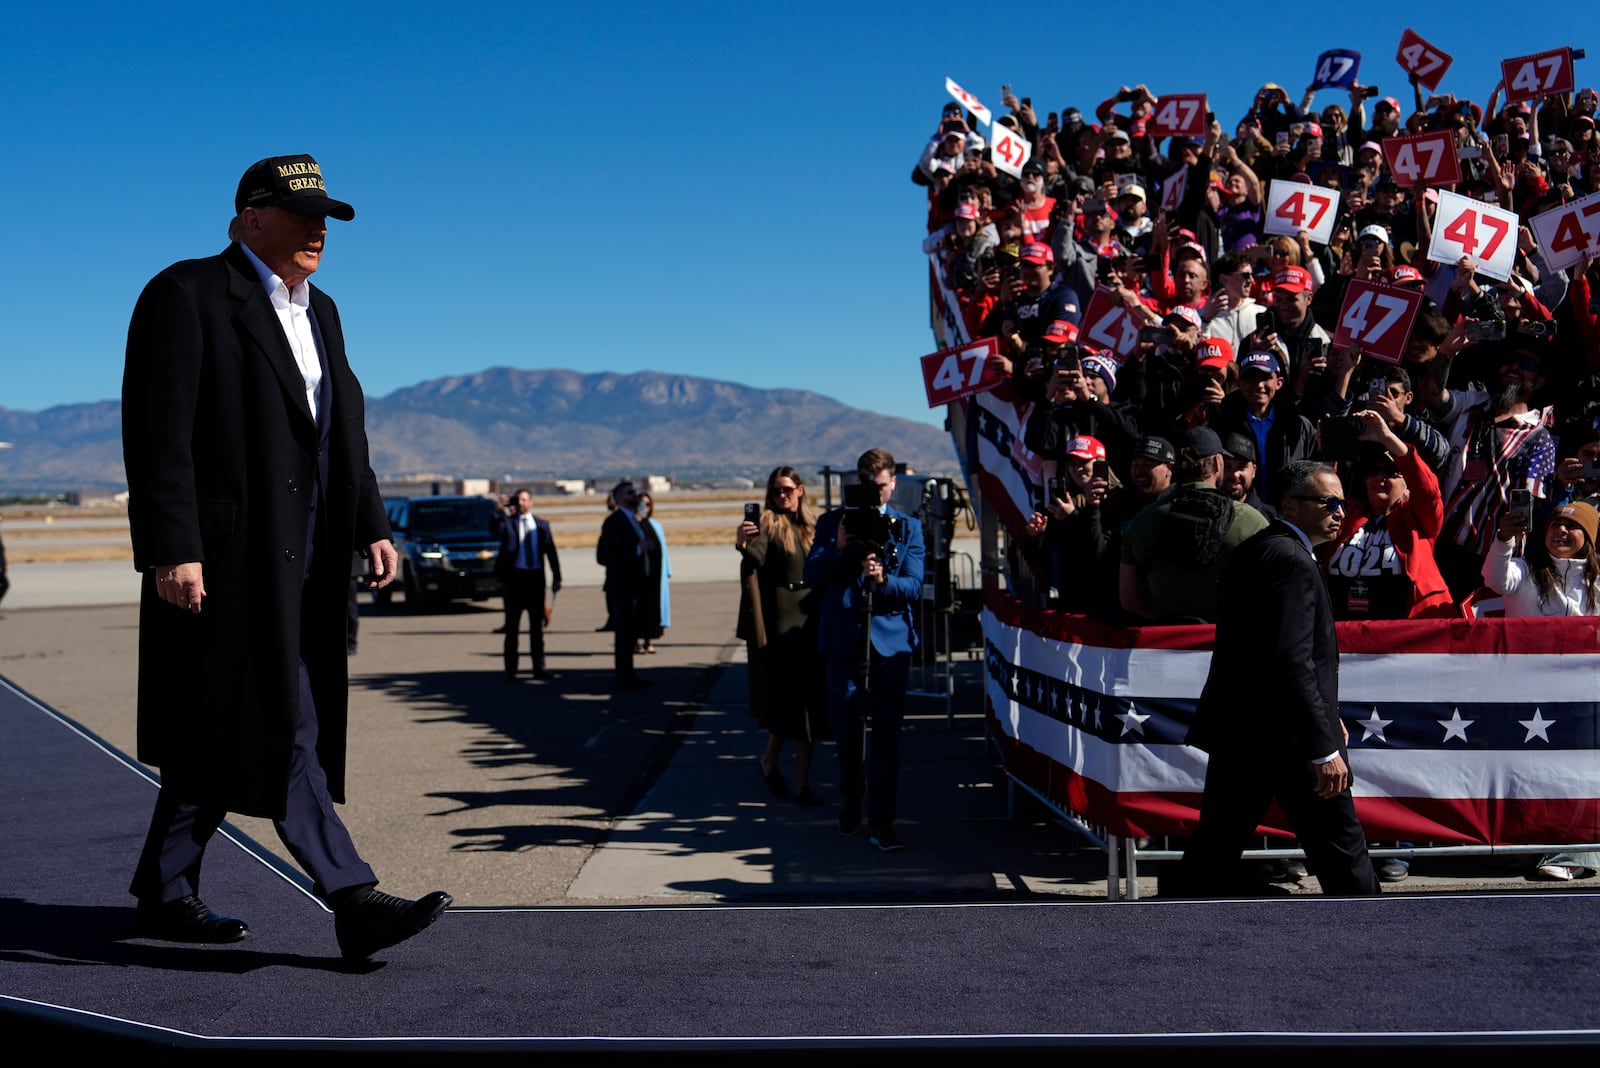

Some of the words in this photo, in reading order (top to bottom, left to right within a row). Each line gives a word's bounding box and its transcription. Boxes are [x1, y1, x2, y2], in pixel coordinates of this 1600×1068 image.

[1317, 57, 1354, 83] 47
[1403, 43, 1444, 76] 47
[1512, 54, 1562, 93] 47
[1156, 100, 1200, 131] 47
[996, 135, 1025, 168] 47
[1394, 138, 1445, 180] 47
[277, 162, 308, 177] MAKE
[289, 177, 318, 191] GREAT
[1276, 191, 1331, 230] 47
[1444, 208, 1509, 261] 47
[1088, 306, 1139, 356] 47
[1342, 290, 1409, 344] 47
[933, 344, 990, 392] 47
[1198, 344, 1222, 360] MAGA
[1328, 544, 1402, 578] 2024
